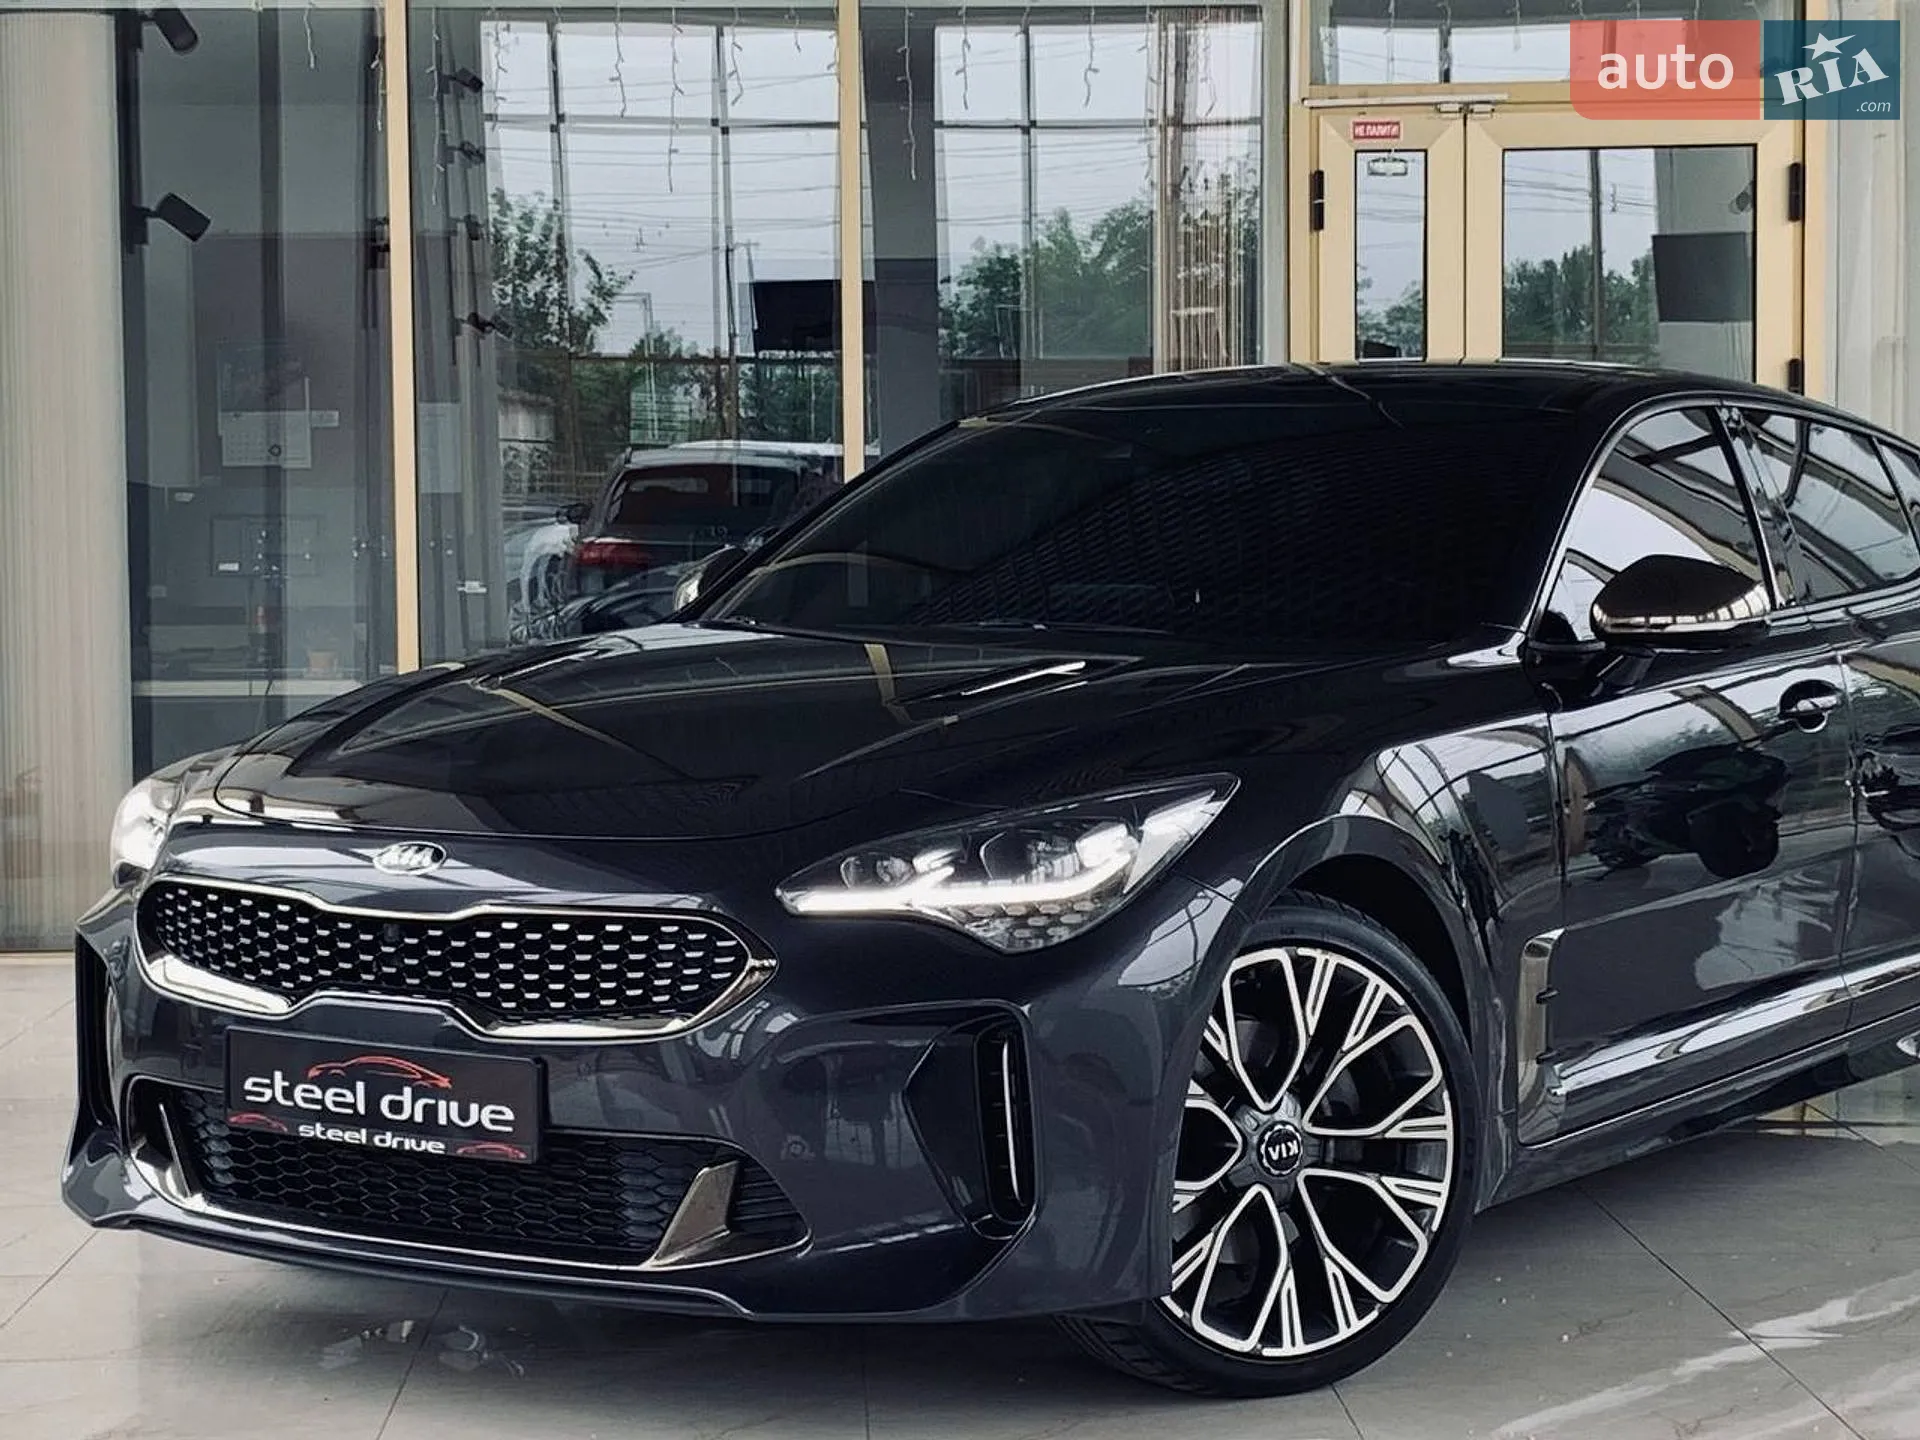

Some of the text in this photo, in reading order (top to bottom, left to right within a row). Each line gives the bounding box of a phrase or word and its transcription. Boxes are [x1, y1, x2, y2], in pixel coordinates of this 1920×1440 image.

[243, 1070, 515, 1132] steel drive
[299, 1122, 446, 1154] steel drive
[1267, 1140, 1299, 1161] KIA
